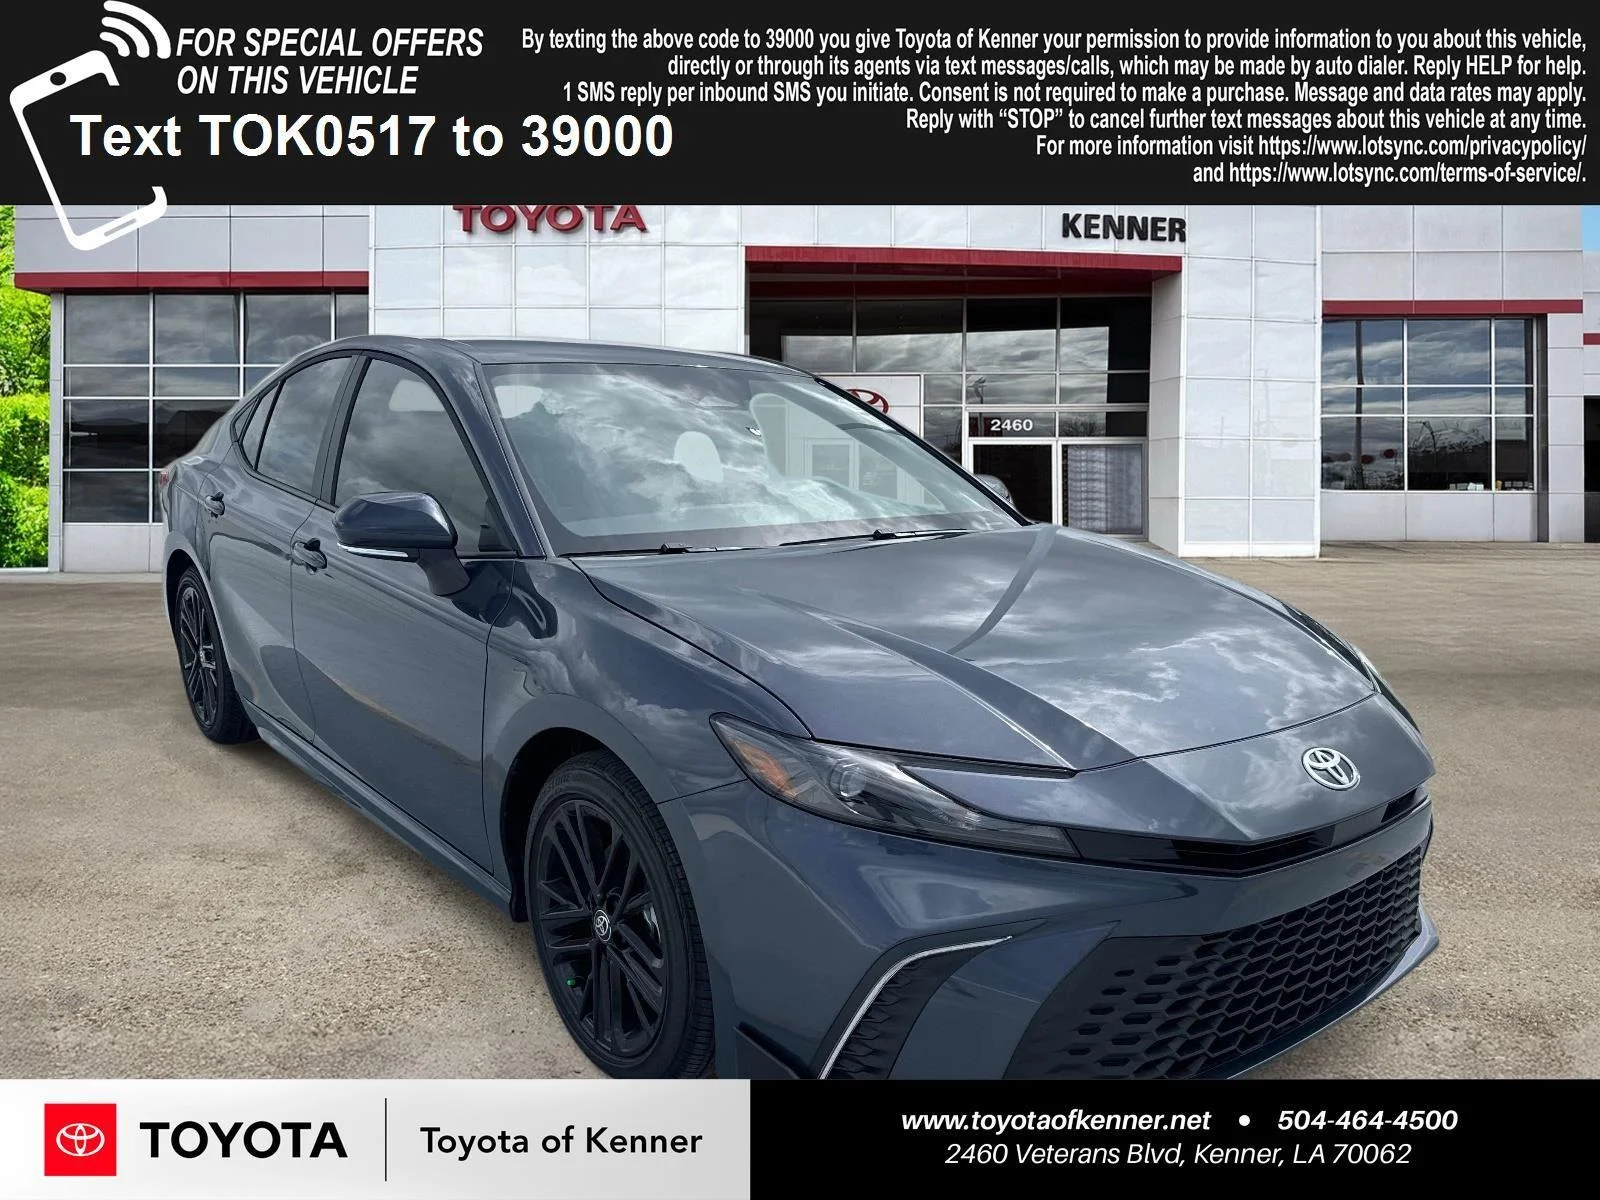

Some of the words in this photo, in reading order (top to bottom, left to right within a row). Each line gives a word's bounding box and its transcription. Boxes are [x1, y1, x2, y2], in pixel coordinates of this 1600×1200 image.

[453, 205, 647, 232] TOYOTA
[1062, 213, 1186, 242] KENNER
[990, 419, 1033, 431] 2460
